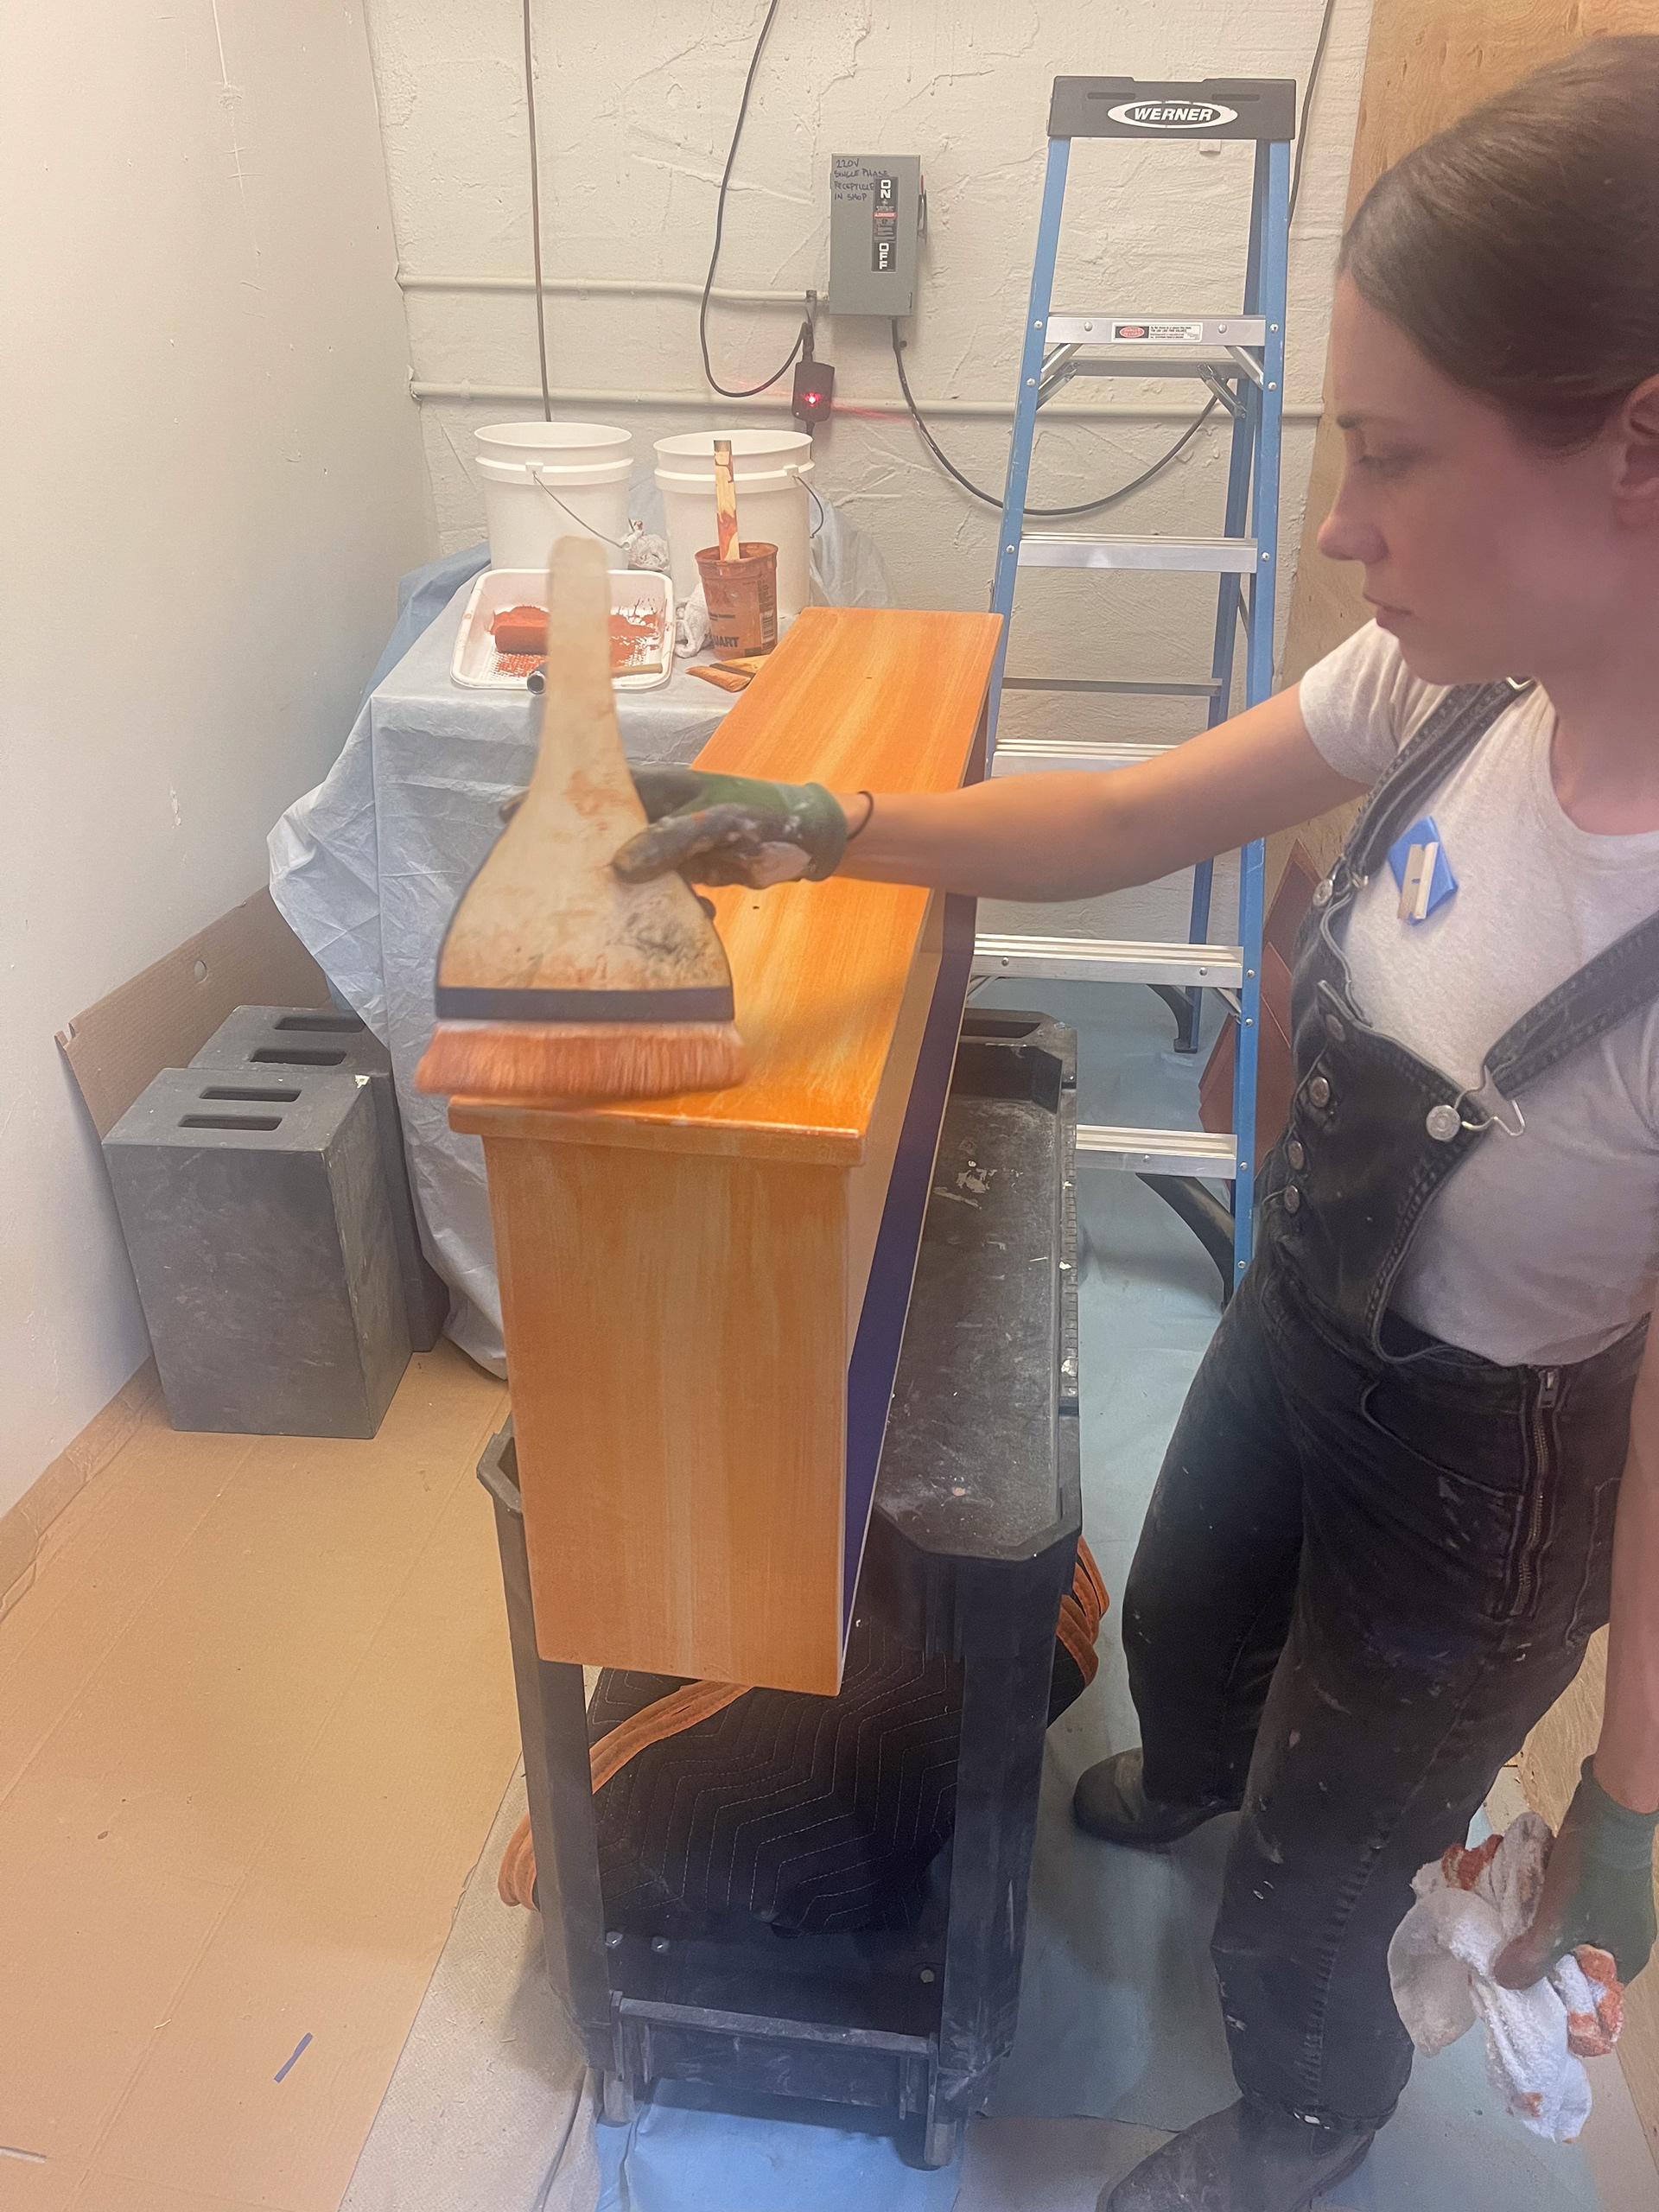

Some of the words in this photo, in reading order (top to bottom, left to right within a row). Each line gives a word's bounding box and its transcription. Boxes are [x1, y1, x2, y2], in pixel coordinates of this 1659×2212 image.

[1135, 107, 1213, 121] WERNER
[836, 157, 860, 168] 220V
[861, 168, 889, 177] PHASE
[880, 179, 892, 199] ON
[834, 192, 843, 200] IN
[847, 193, 868, 201] SHOP
[879, 242, 889, 270] OFF
